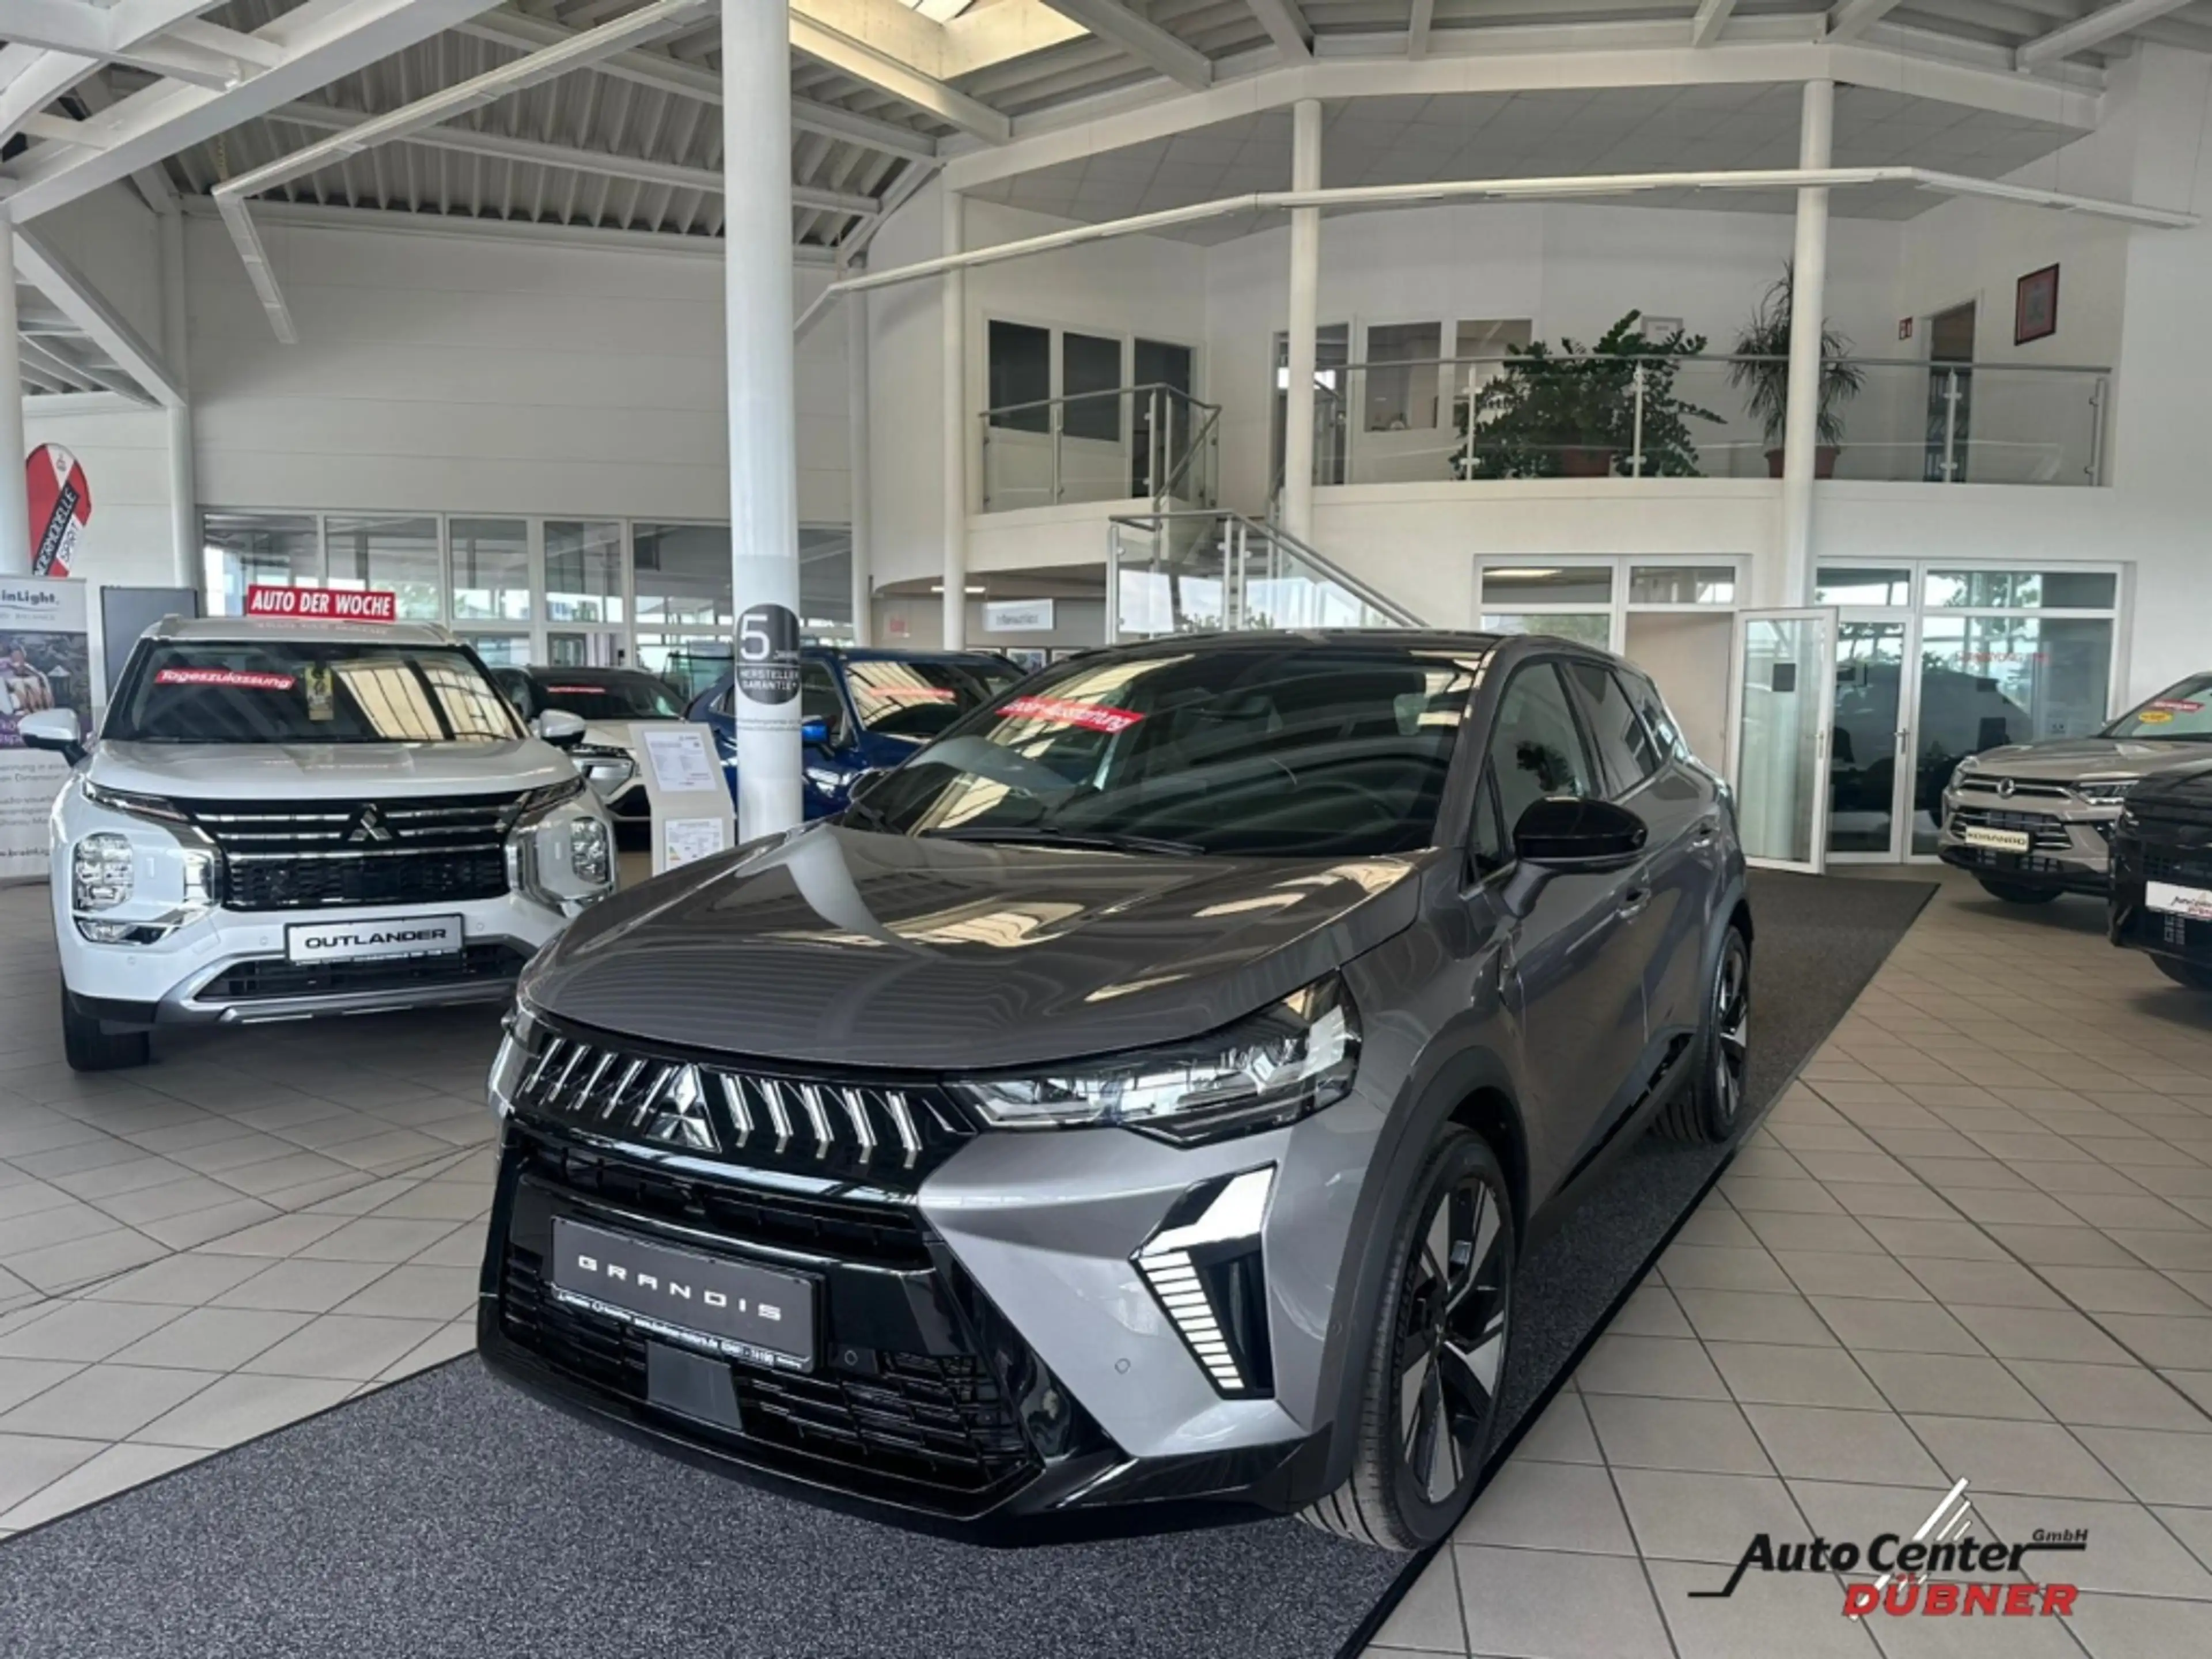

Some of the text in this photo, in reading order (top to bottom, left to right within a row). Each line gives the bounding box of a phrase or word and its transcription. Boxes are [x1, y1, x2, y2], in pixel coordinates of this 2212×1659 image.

[251, 590, 392, 616] AUTO DER WOCHE
[740, 613, 770, 660] 5
[161, 669, 293, 690] Tageszulassung
[305, 928, 447, 949] OUTLANDER
[578, 1255, 782, 1321] GRANDIS
